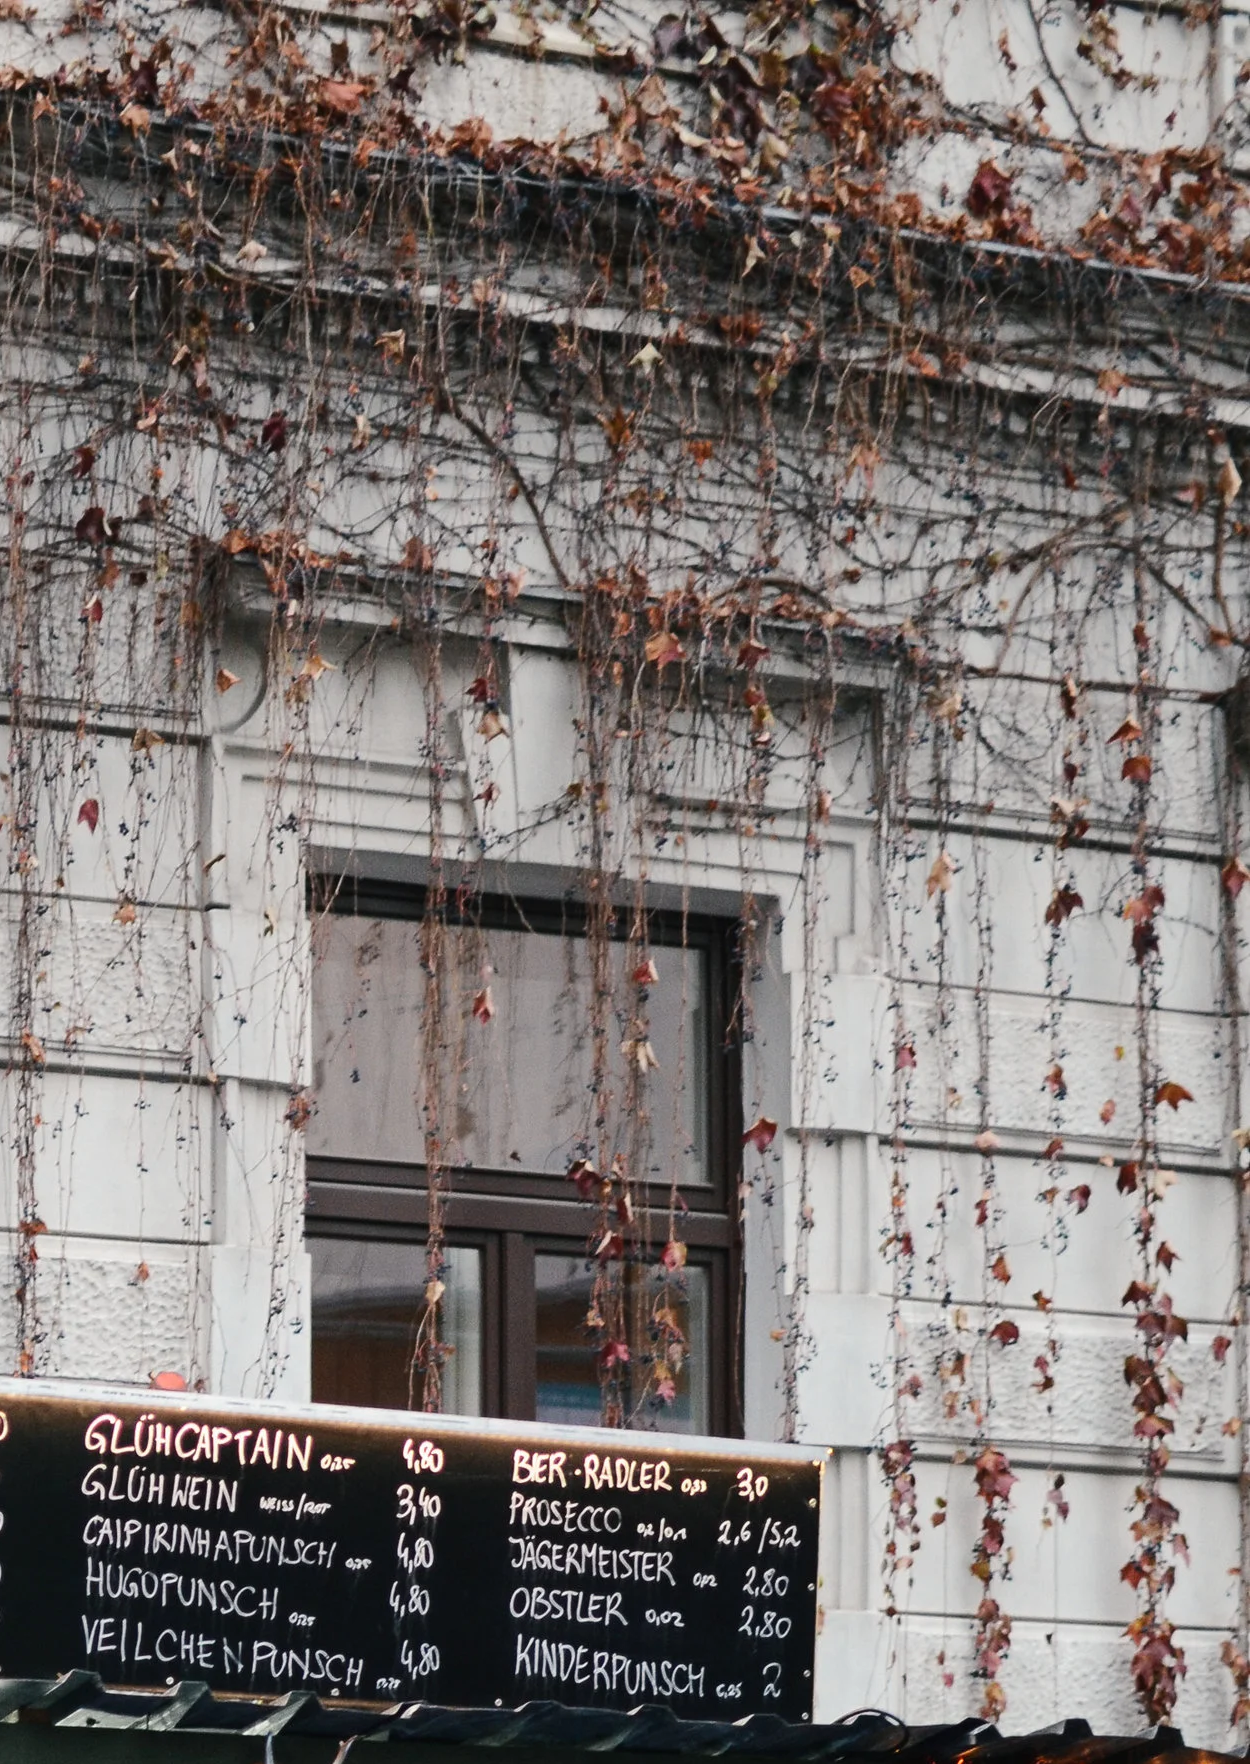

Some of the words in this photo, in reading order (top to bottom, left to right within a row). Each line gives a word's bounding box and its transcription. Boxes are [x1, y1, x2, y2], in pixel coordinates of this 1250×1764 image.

[84, 1413, 313, 1470] GLÜHCAPTAIN
[403, 1438, 443, 1474] 4,80
[81, 1464, 238, 1513] GLÜHWEIN
[397, 1484, 441, 1524] 3,40
[584, 1454, 672, 1491] RADLER
[737, 1468, 768, 1502] 3,0
[509, 1492, 622, 1532] PROSECCO
[83, 1515, 336, 1568] CAIPIRINHAPUNSCH
[397, 1533, 433, 1574] 4,80
[509, 1537, 676, 1585] JÄGERMEISTER
[742, 1566, 788, 1597] 2,80
[85, 1557, 278, 1620] HUGOPUNSCH
[390, 1581, 430, 1616] 4,80
[509, 1587, 628, 1626] OBSTLER
[738, 1606, 791, 1638] 2,80
[82, 1614, 363, 1685] VEILCHENPUNSCH
[401, 1640, 440, 1679] 4,80
[515, 1634, 705, 1697] KINDERPUNSCH
[762, 1662, 781, 1697] 2
